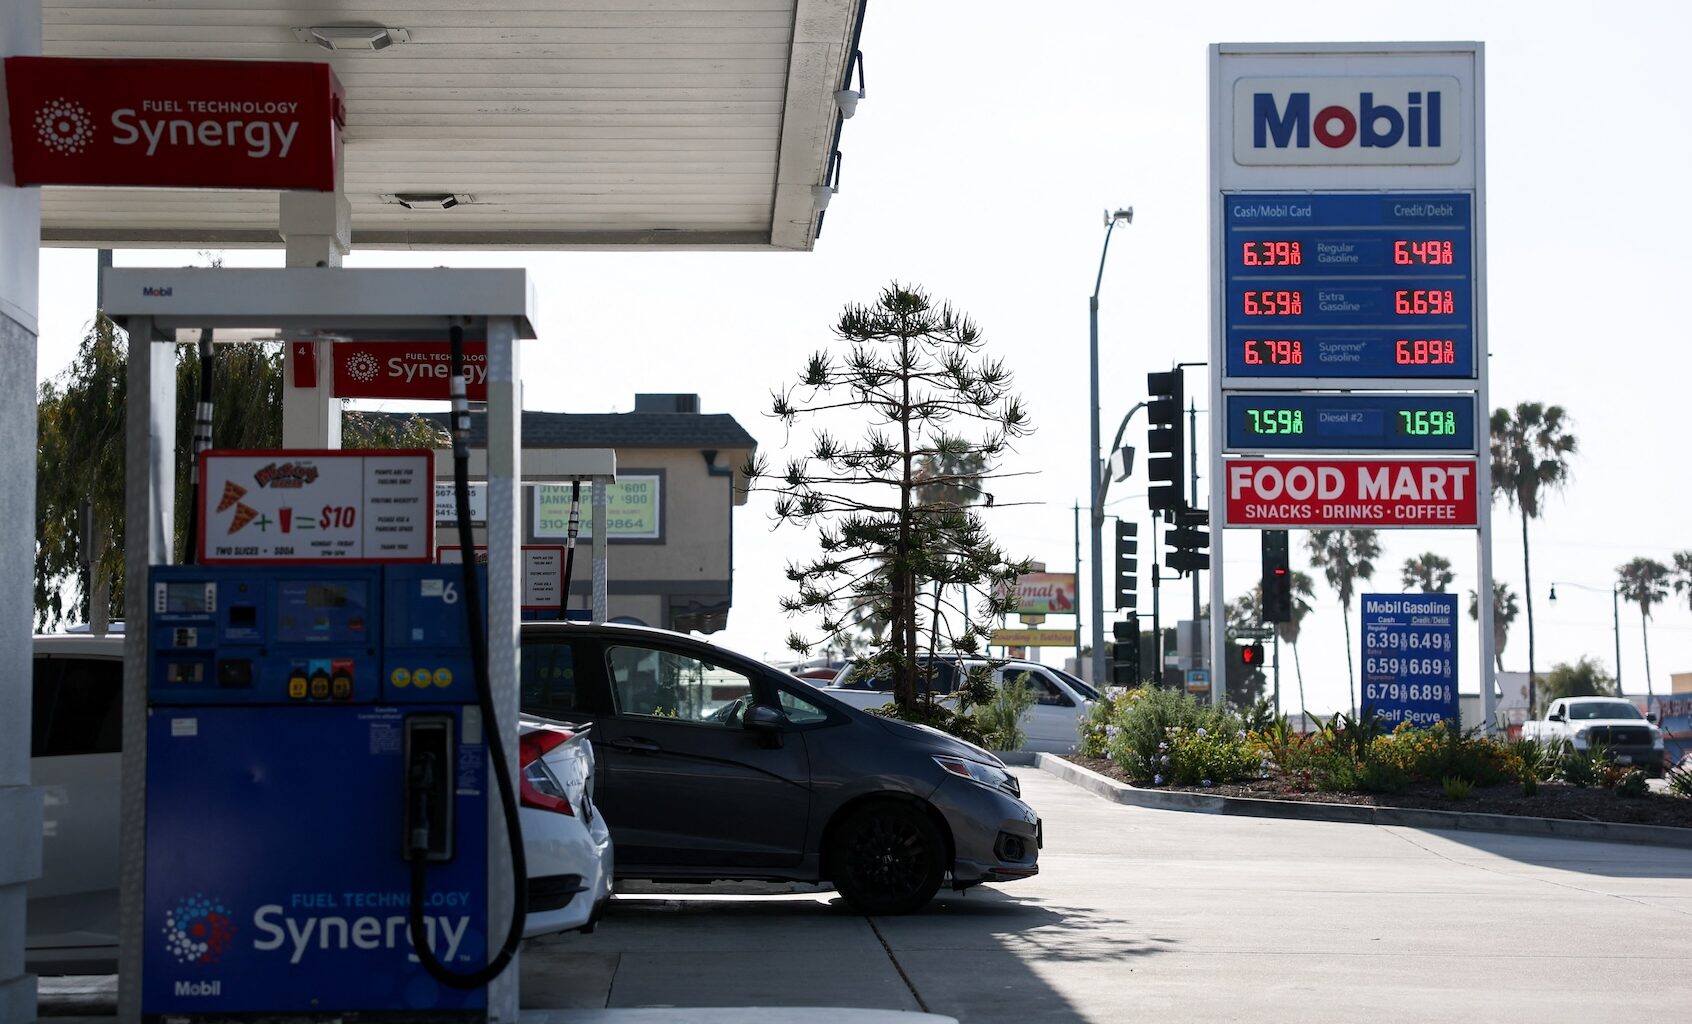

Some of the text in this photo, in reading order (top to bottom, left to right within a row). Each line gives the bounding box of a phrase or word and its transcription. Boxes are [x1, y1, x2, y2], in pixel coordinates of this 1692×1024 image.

[143, 100, 298, 114] FUEL TECHNOLOGY
[1253, 91, 1441, 149] Mobil
[110, 109, 299, 158] Synergy
[1233, 204, 1312, 218] Cash/Mobil Card
[1393, 204, 1454, 217] Credit/Debit
[1243, 242, 1290, 266] 6.39
[1317, 243, 1355, 254] Regular
[1394, 240, 1441, 265] 6.49
[1318, 254, 1359, 263] Gasoline
[143, 287, 172, 296] Mobil
[1319, 292, 1345, 301] Extra
[1244, 291, 1290, 315] 6.59
[1319, 302, 1360, 312] Gasoline
[1395, 290, 1442, 315] 6.69
[298, 346, 307, 356] 4
[1245, 340, 1291, 365] 6.79
[1319, 353, 1360, 362] Gasoline
[1396, 340, 1443, 365] 6.89
[387, 357, 488, 385] Synegy
[1319, 413, 1363, 423] Diesel #2
[1230, 466, 1470, 500] FOOD MART
[319, 504, 356, 531] $10
[1245, 504, 1456, 519] SNACKS DRINKS COFFEE
[216, 547, 234, 555] TWO
[274, 547, 294, 555] SODA
[442, 581, 458, 605] 6
[1366, 601, 1451, 614] Mobil Gasoline
[1366, 632, 1399, 648] 6.39
[1409, 633, 1442, 649] 6.49
[1366, 658, 1399, 674] 6.59
[1409, 659, 1442, 675] 6.69
[1366, 684, 1399, 699] 6.79
[1409, 684, 1442, 700] 6.89
[1376, 708, 1441, 722] Self Serve
[292, 893, 337, 908] FUEL
[175, 980, 221, 996] Mobil
